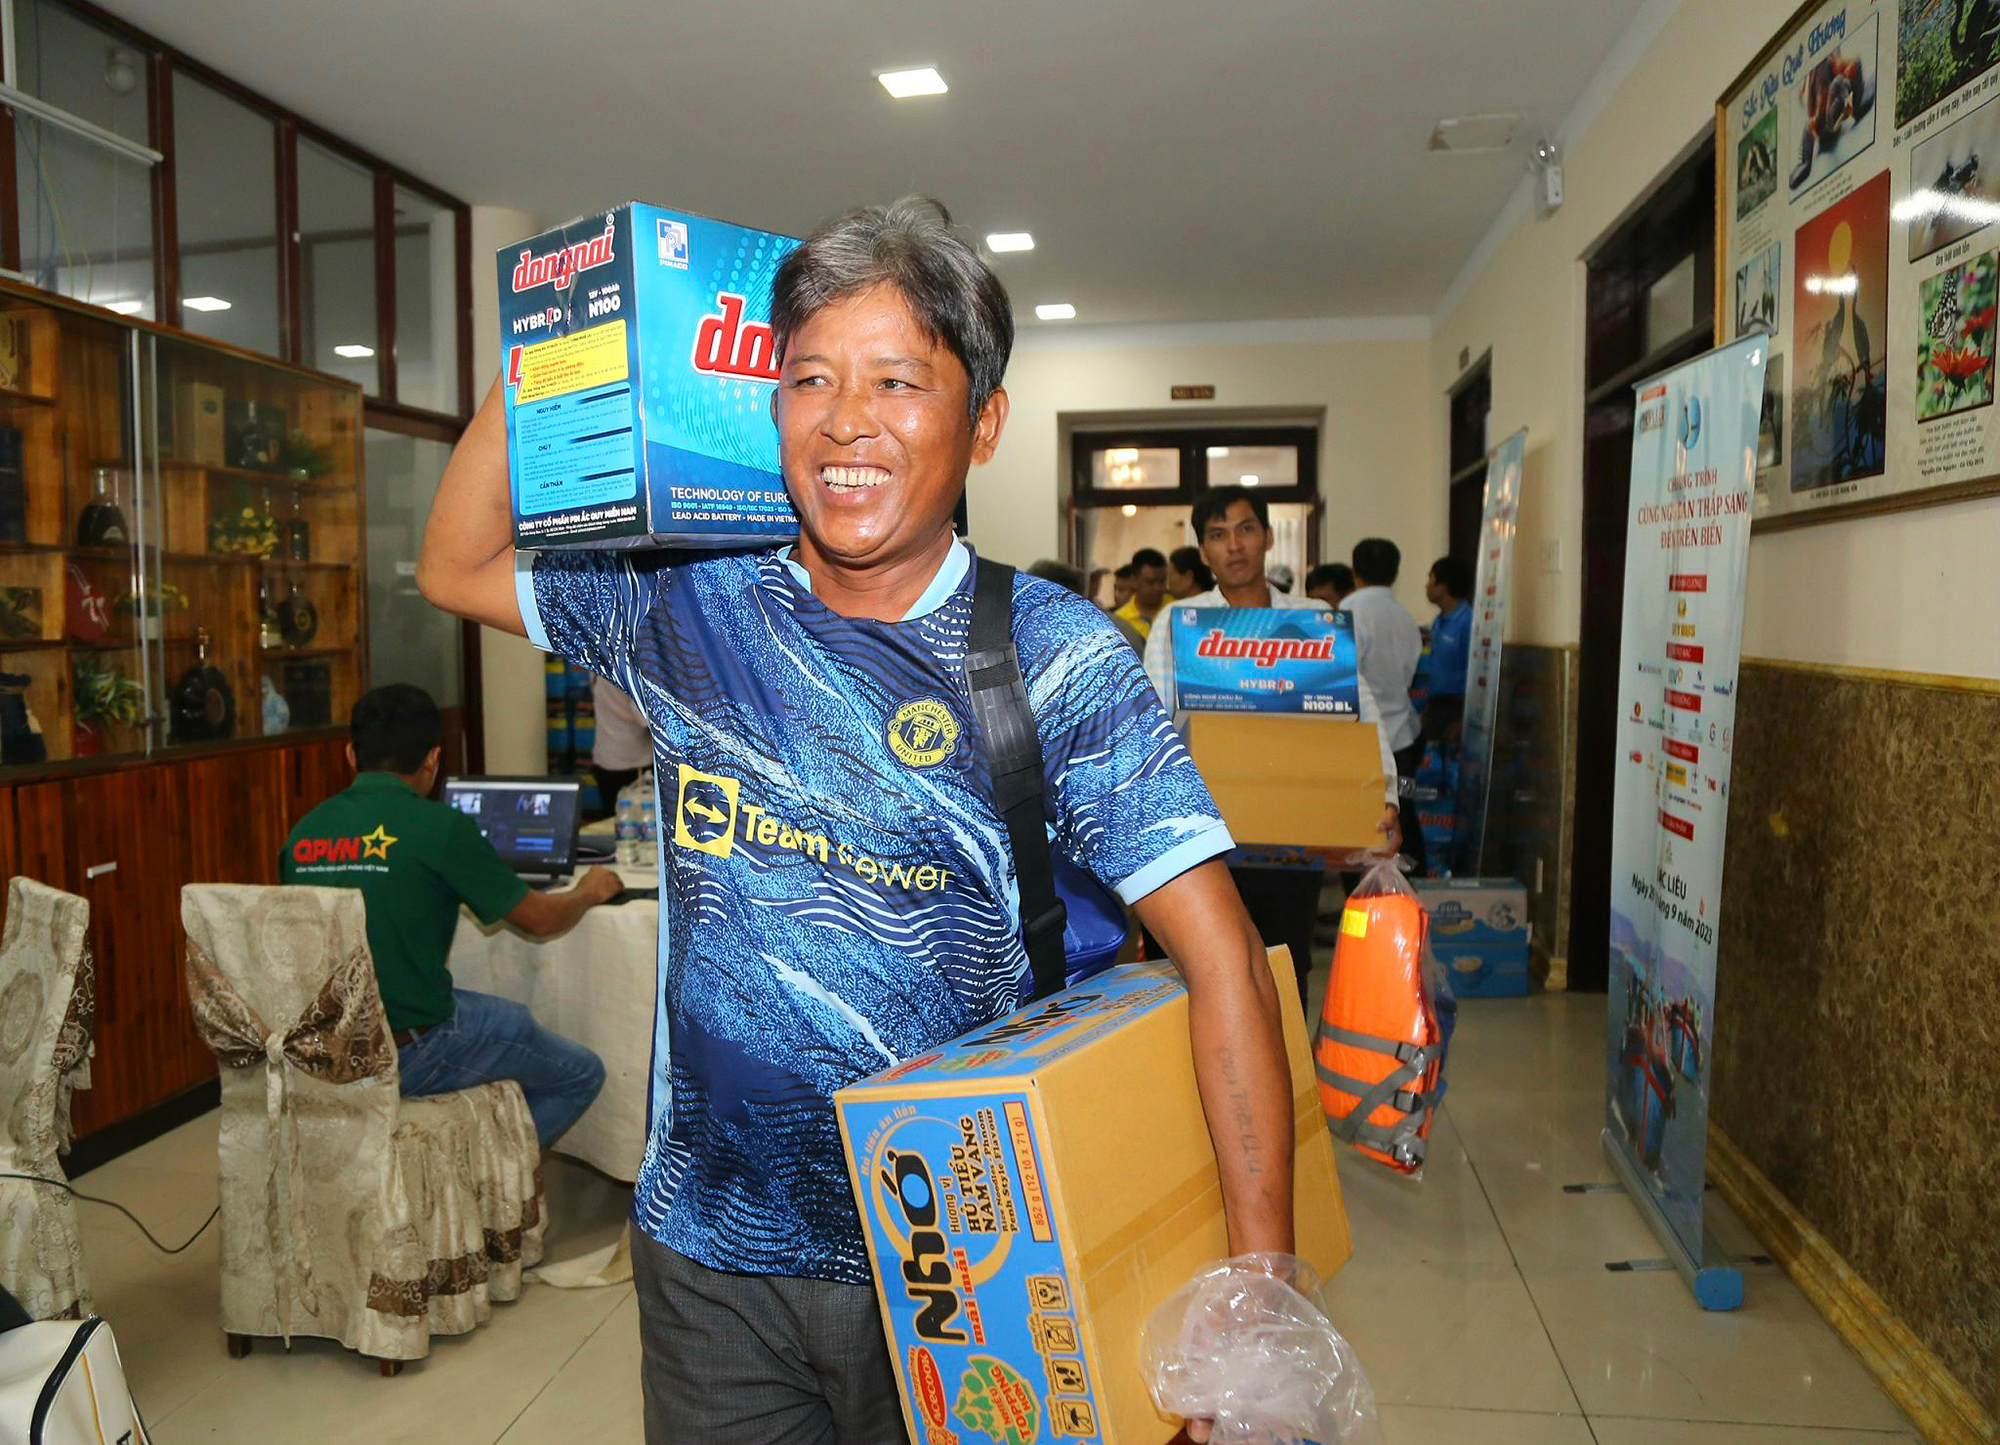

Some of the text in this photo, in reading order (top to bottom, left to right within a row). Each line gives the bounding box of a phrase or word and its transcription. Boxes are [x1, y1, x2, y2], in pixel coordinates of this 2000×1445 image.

[588, 294, 621, 319] N100
[670, 486, 745, 502] TECHNOLOGY
[747, 490, 761, 503] OF
[671, 501, 682, 509] ISO
[683, 502, 698, 510] 9001
[1724, 486, 1748, 516] SÁNG
[535, 519, 543, 528] TY
[620, 506, 638, 517] NAM
[672, 511, 691, 520] LEAD
[693, 512, 711, 521] ACID
[711, 512, 742, 522] BATTERY
[746, 514, 765, 523] MADE
[902, 703, 953, 735] MANCHESTER
[1304, 700, 1334, 711] N100
[895, 743, 932, 763] UNITED
[293, 836, 361, 863] QPVN
[1667, 873, 1687, 900] LIÊU
[1632, 872, 1649, 899] Ngày
[1671, 903, 1678, 920] 9
[1677, 909, 1695, 932] năm
[1695, 918, 1713, 946] 2023
[976, 1110, 992, 1156] Phnom
[1015, 1132, 1027, 1145] 71
[960, 1116, 998, 1233] NAM VANG
[985, 1107, 1019, 1233] Penh Style Flavour
[1022, 1173, 1039, 1192] (12
[949, 1146, 982, 1233] HỦ TIẾU
[943, 1193, 962, 1233] Hương
[1000, 1209, 1009, 1233] Rice
[1031, 1206, 1045, 1227] 852
[881, 1149, 967, 1342] Nhớ
[951, 1248, 986, 1345] mãi mãi
[990, 1364, 1031, 1440] TOPPING
